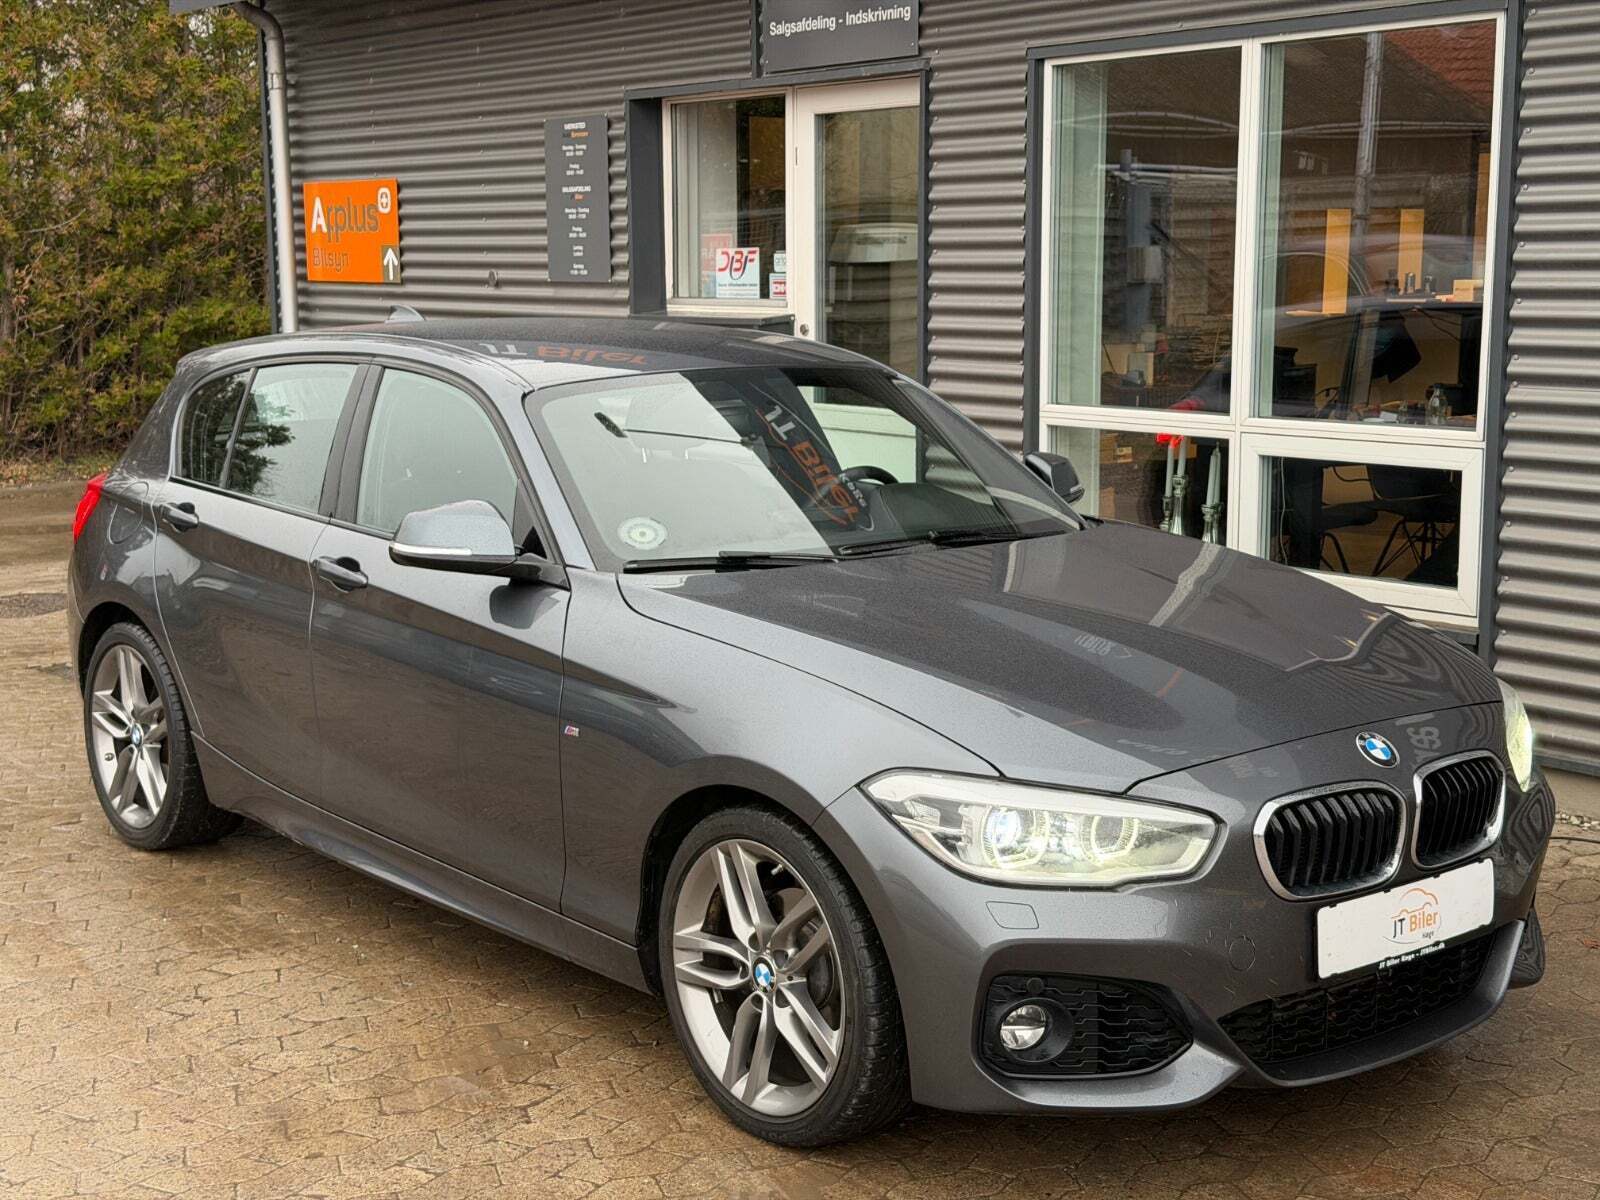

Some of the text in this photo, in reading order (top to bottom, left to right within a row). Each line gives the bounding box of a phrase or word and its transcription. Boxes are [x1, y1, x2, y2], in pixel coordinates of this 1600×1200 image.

[769, 15, 836, 37] Salgsafdeling
[846, 5, 911, 26] Indskrivning
[313, 247, 349, 272] Bilsyn
[1392, 911, 1439, 939] JT Biler
